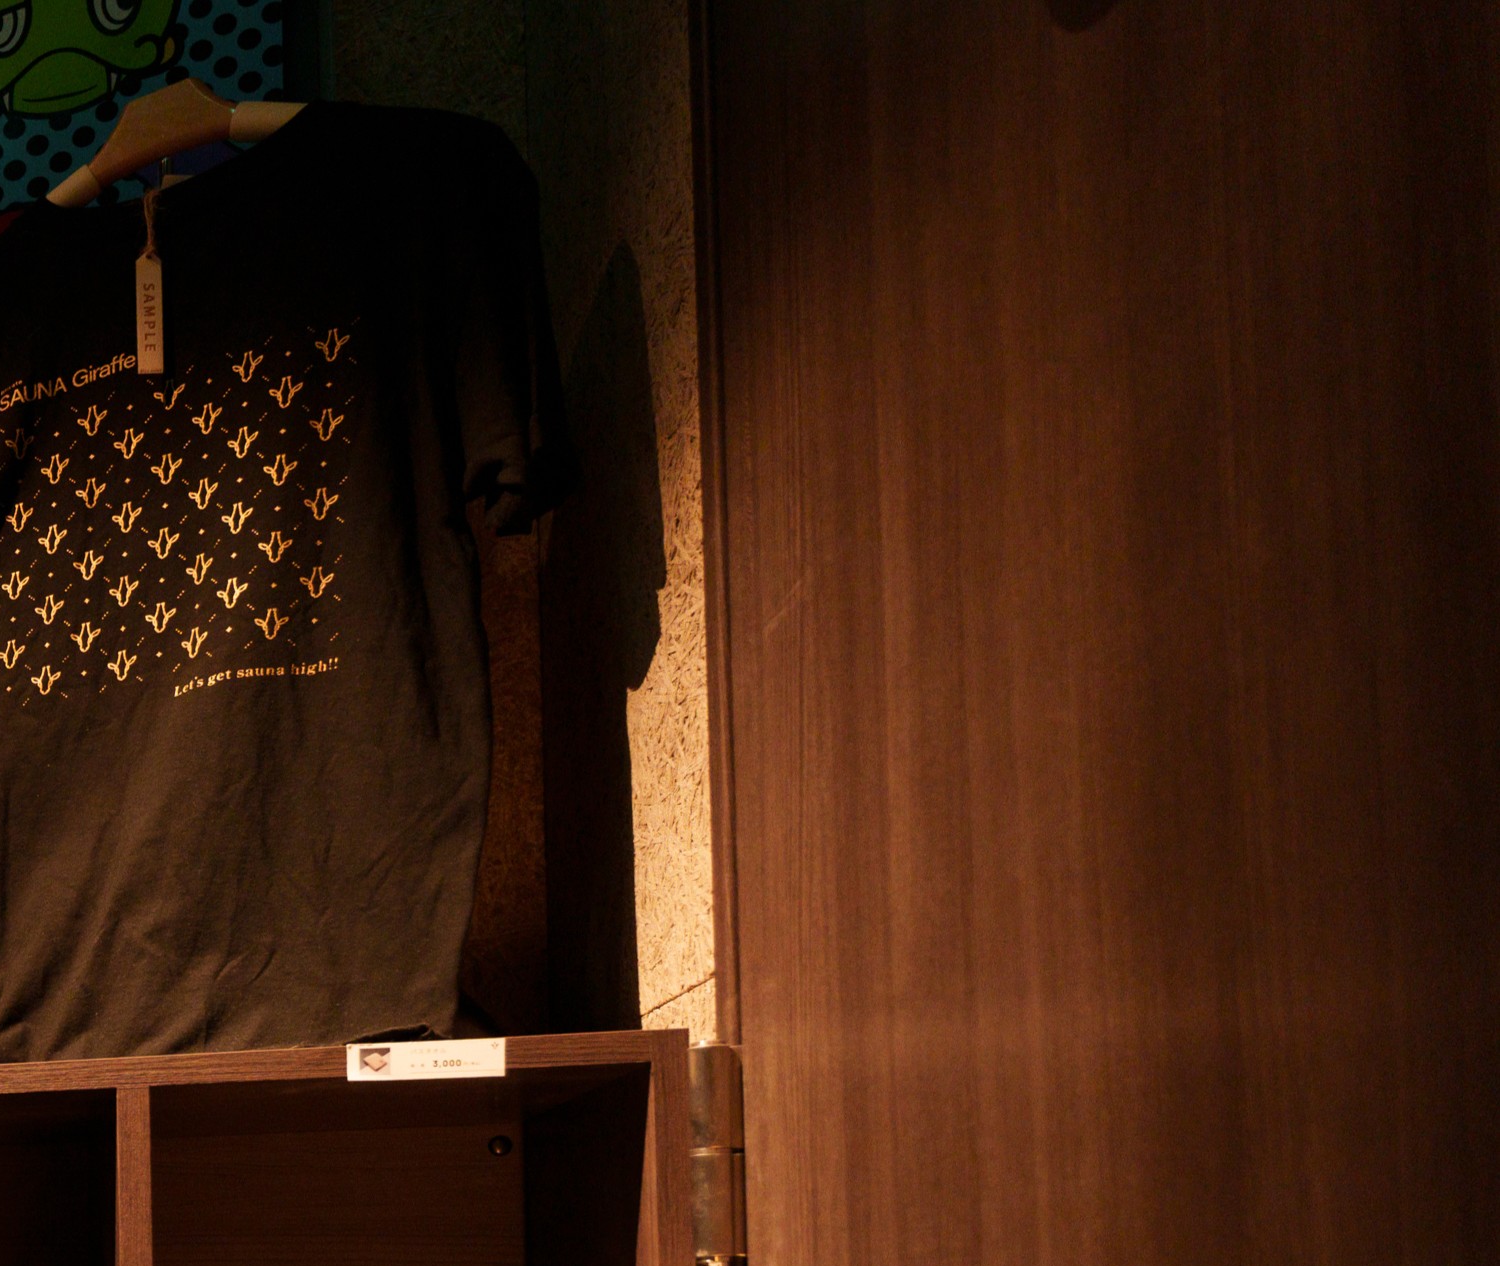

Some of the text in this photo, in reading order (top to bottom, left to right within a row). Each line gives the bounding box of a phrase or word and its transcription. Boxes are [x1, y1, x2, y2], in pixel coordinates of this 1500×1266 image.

[143, 284, 156, 352] SAMPLE
[0, 353, 136, 412] SAUNA Giraffe
[174, 657, 339, 697] Let's get sauna high!!
[433, 1060, 462, 1068] 3,000
